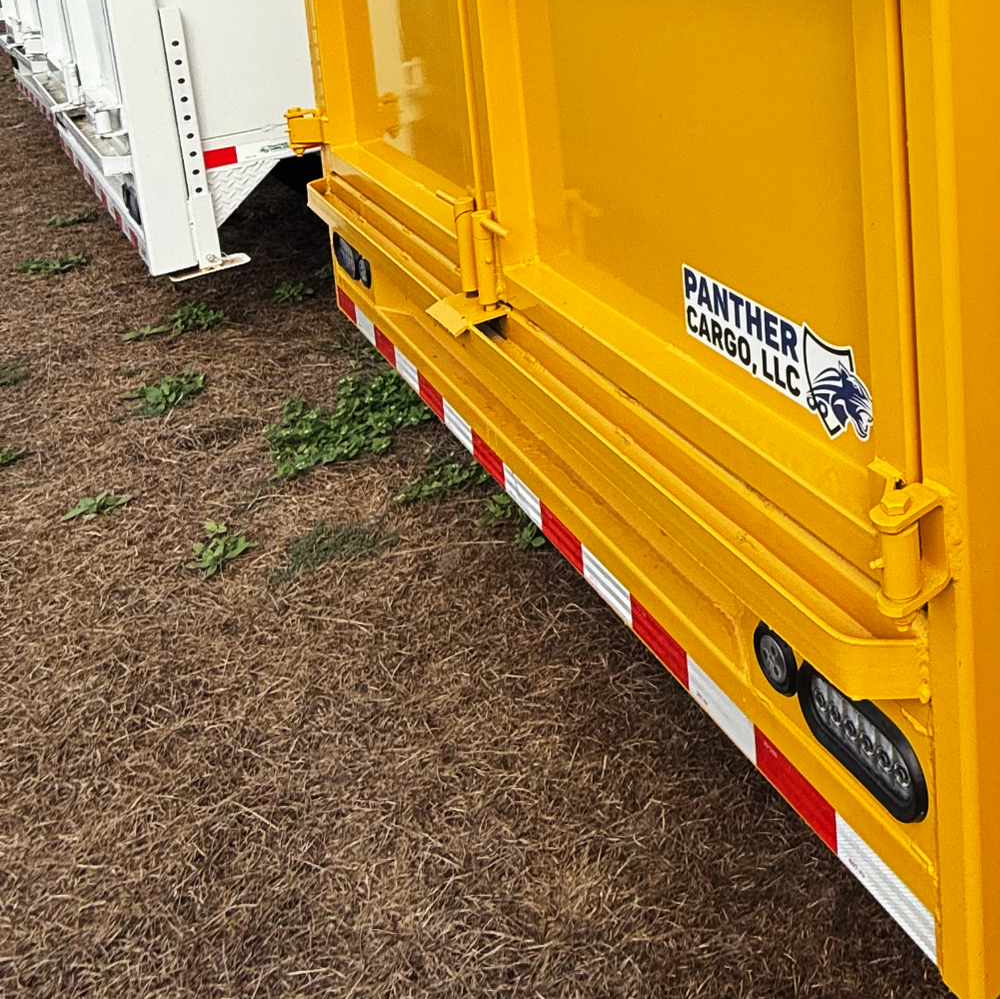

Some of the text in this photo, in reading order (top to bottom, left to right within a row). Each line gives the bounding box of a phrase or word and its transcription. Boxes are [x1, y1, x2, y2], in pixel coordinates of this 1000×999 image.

[683, 266, 799, 363] PANTHER
[686, 304, 801, 397] CARGO, LLC
